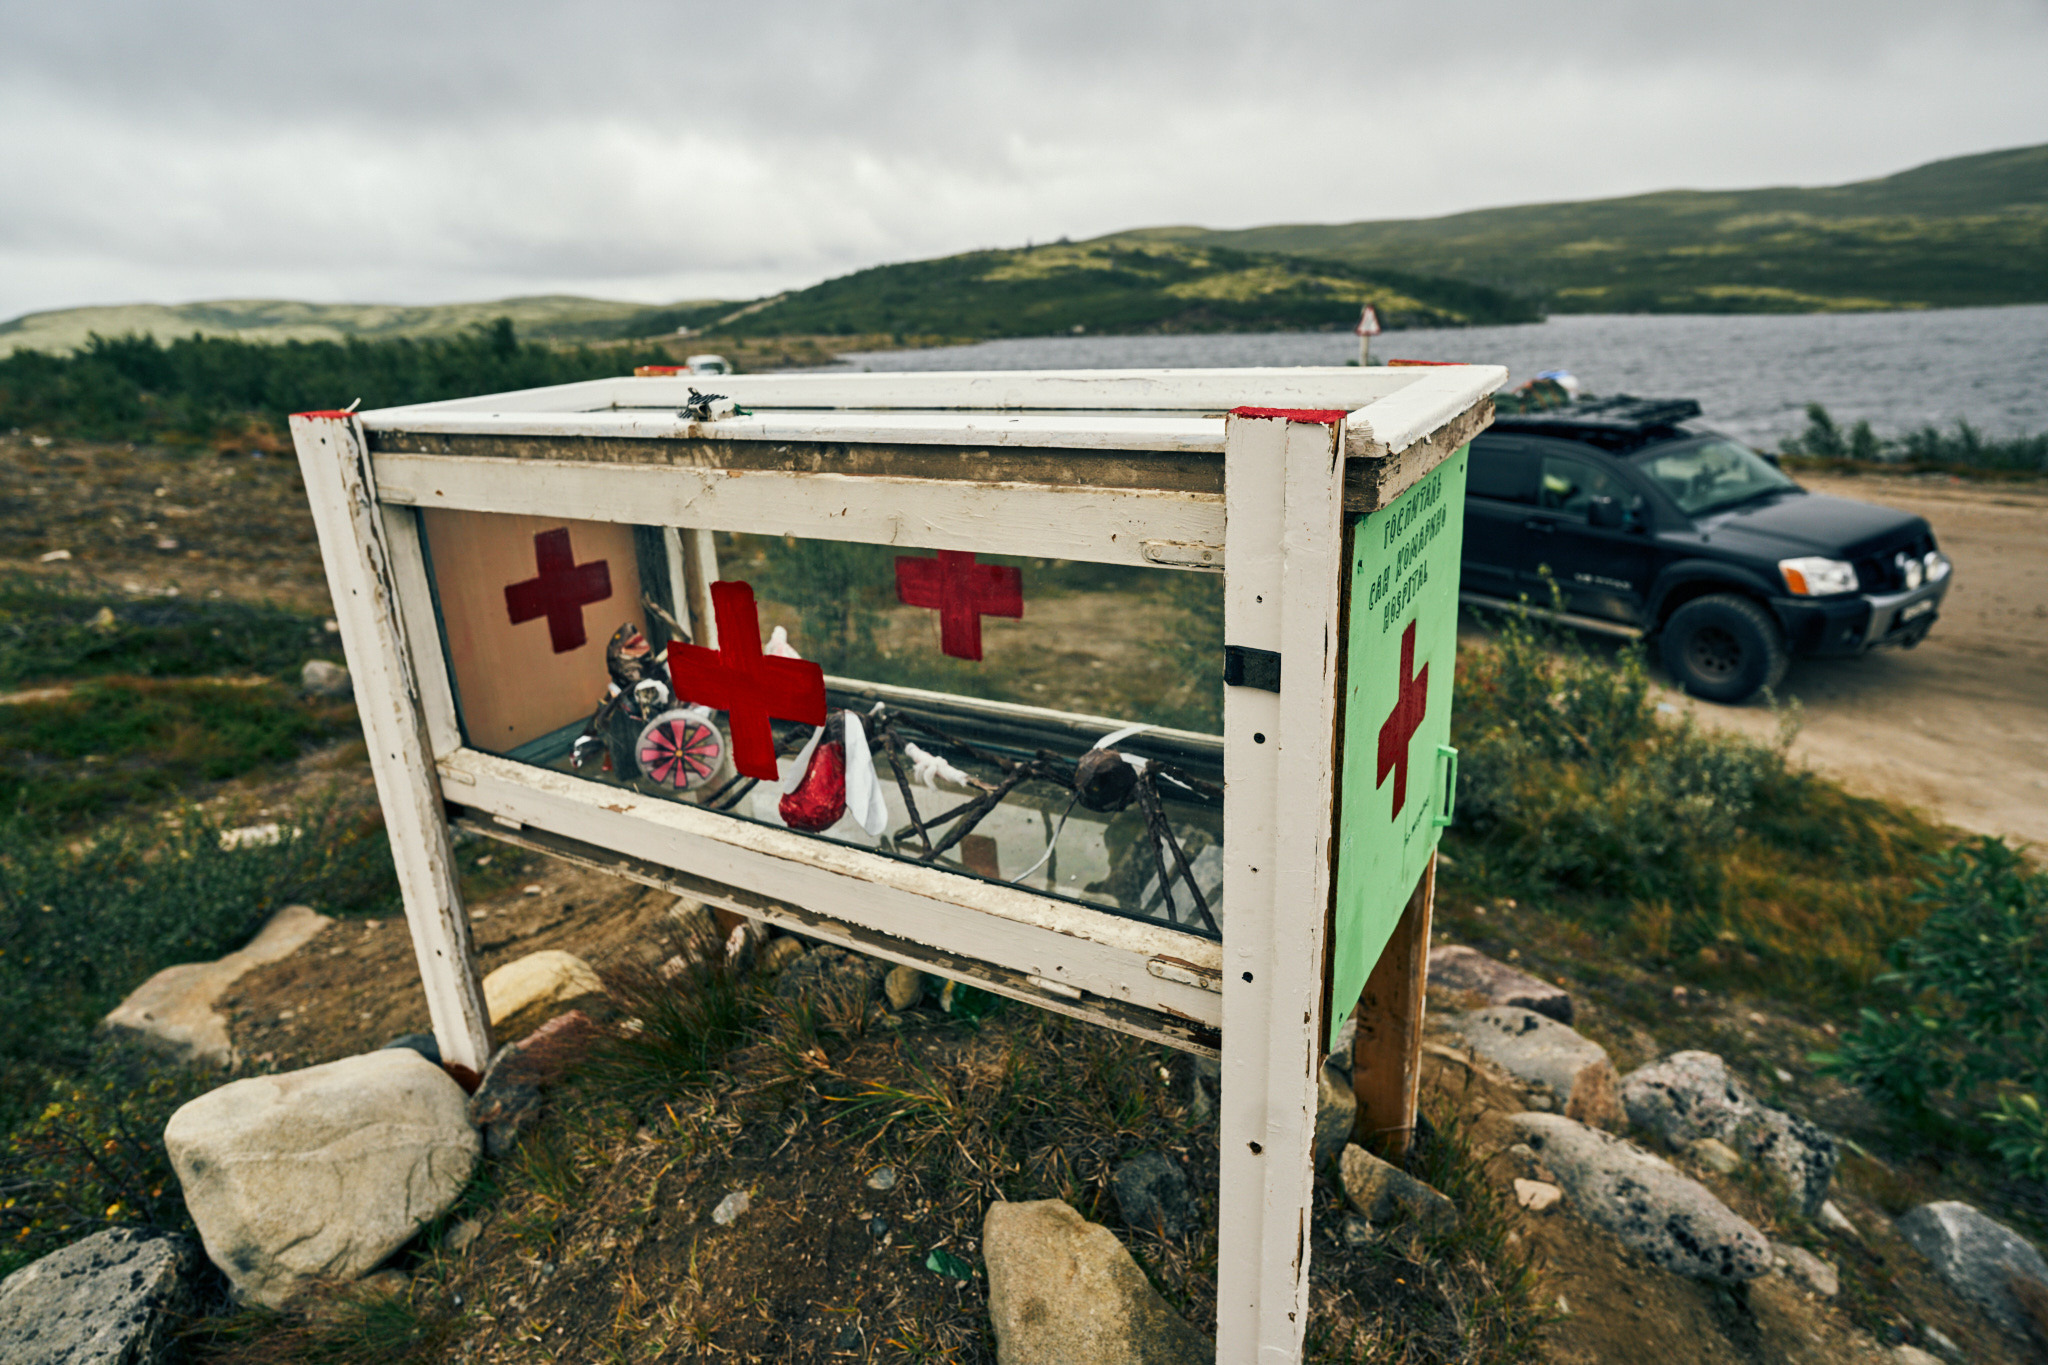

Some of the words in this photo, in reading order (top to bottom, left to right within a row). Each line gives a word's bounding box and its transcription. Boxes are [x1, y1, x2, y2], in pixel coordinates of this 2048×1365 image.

[1384, 472, 1442, 549] ГОСПИТАЛЬ
[1368, 564, 1391, 611] САН
[1383, 559, 1428, 633] HOSPITAL
